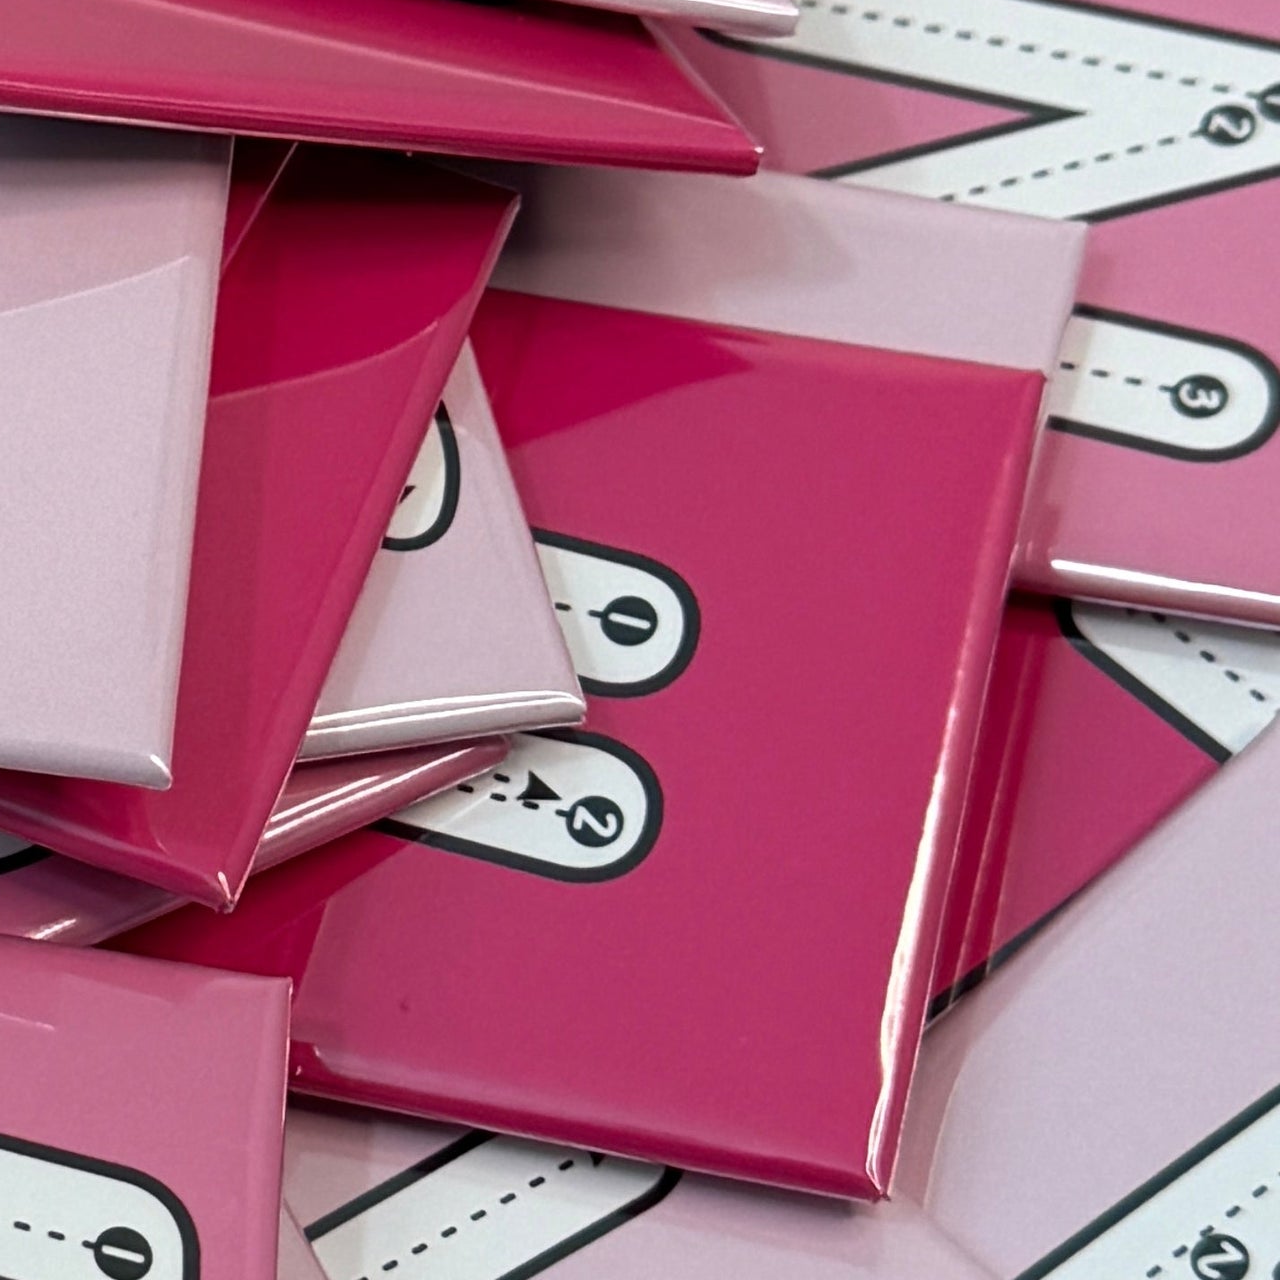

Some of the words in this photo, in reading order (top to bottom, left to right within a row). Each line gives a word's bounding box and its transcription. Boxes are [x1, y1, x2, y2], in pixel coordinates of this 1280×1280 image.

[1202, 109, 1254, 144] 2
[1173, 377, 1225, 415] 3
[569, 800, 620, 843] 2
